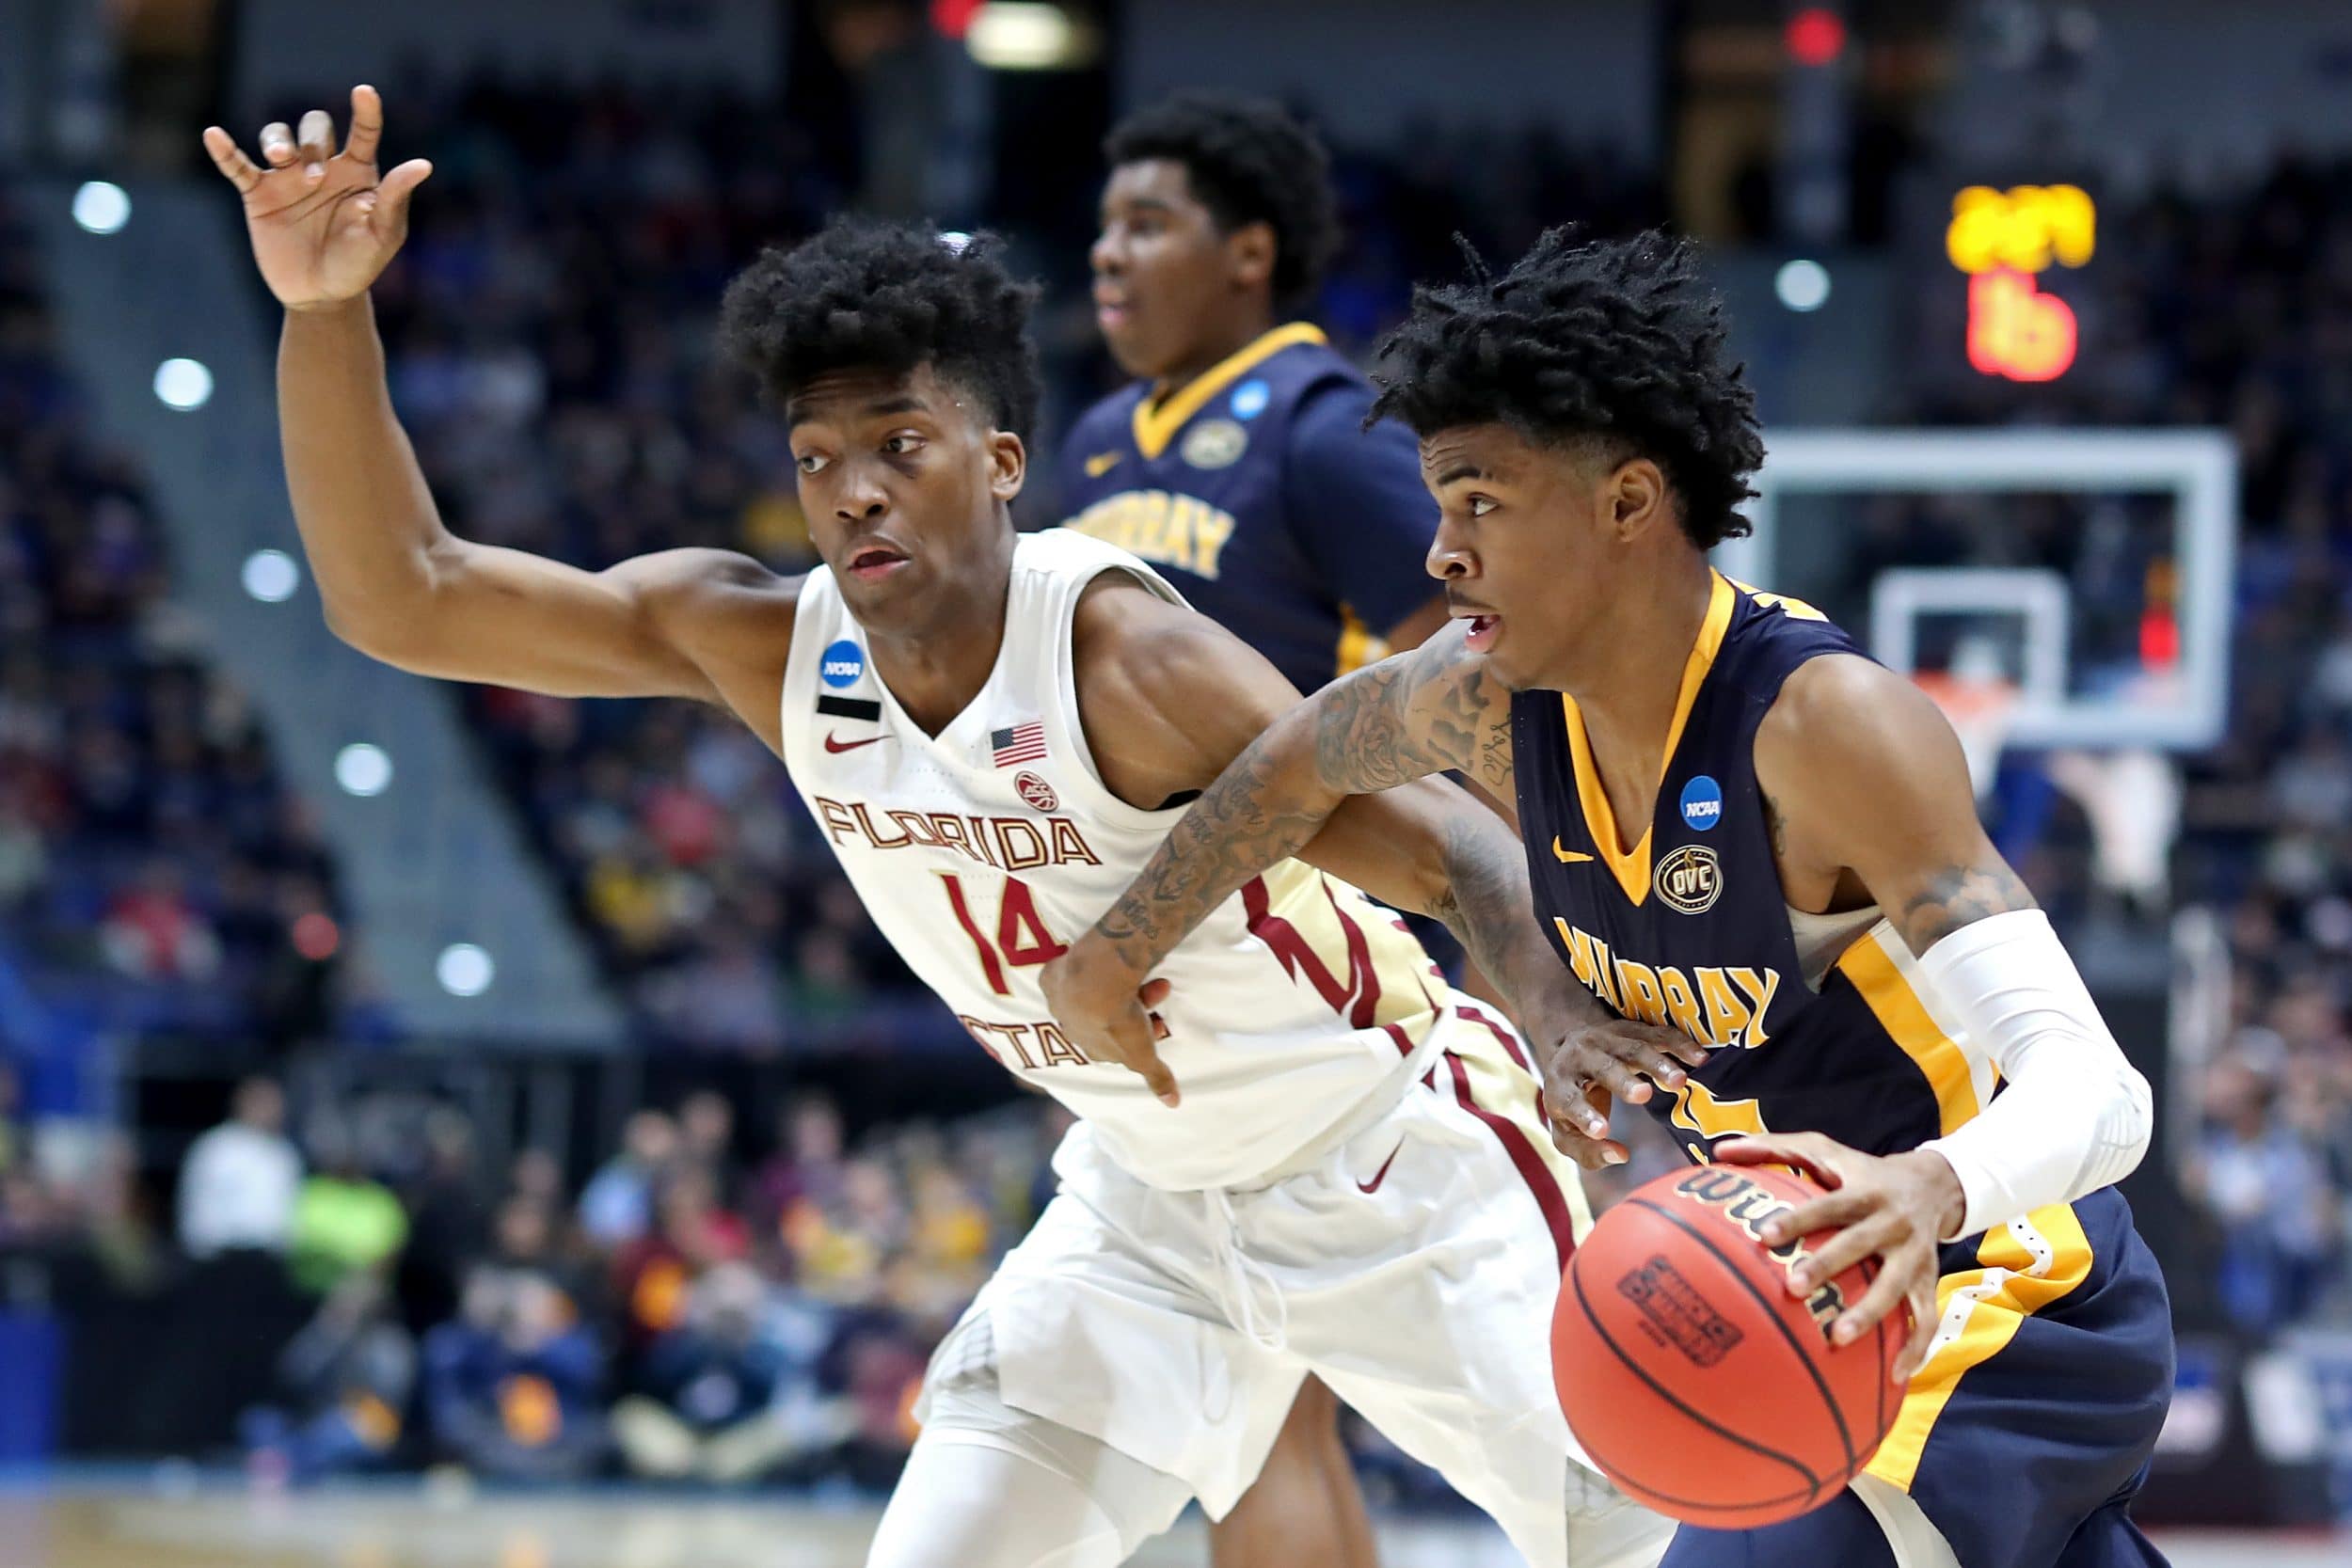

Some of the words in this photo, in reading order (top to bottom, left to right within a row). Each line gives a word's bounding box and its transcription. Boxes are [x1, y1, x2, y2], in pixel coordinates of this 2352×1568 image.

[824, 661, 861, 676] NCAA
[815, 796, 1103, 872] FLORIDA
[1685, 800, 1720, 817] NCAA
[1673, 864, 1712, 895] OVC
[930, 869, 1070, 997] 14
[1552, 916, 1781, 1049] MURRAY
